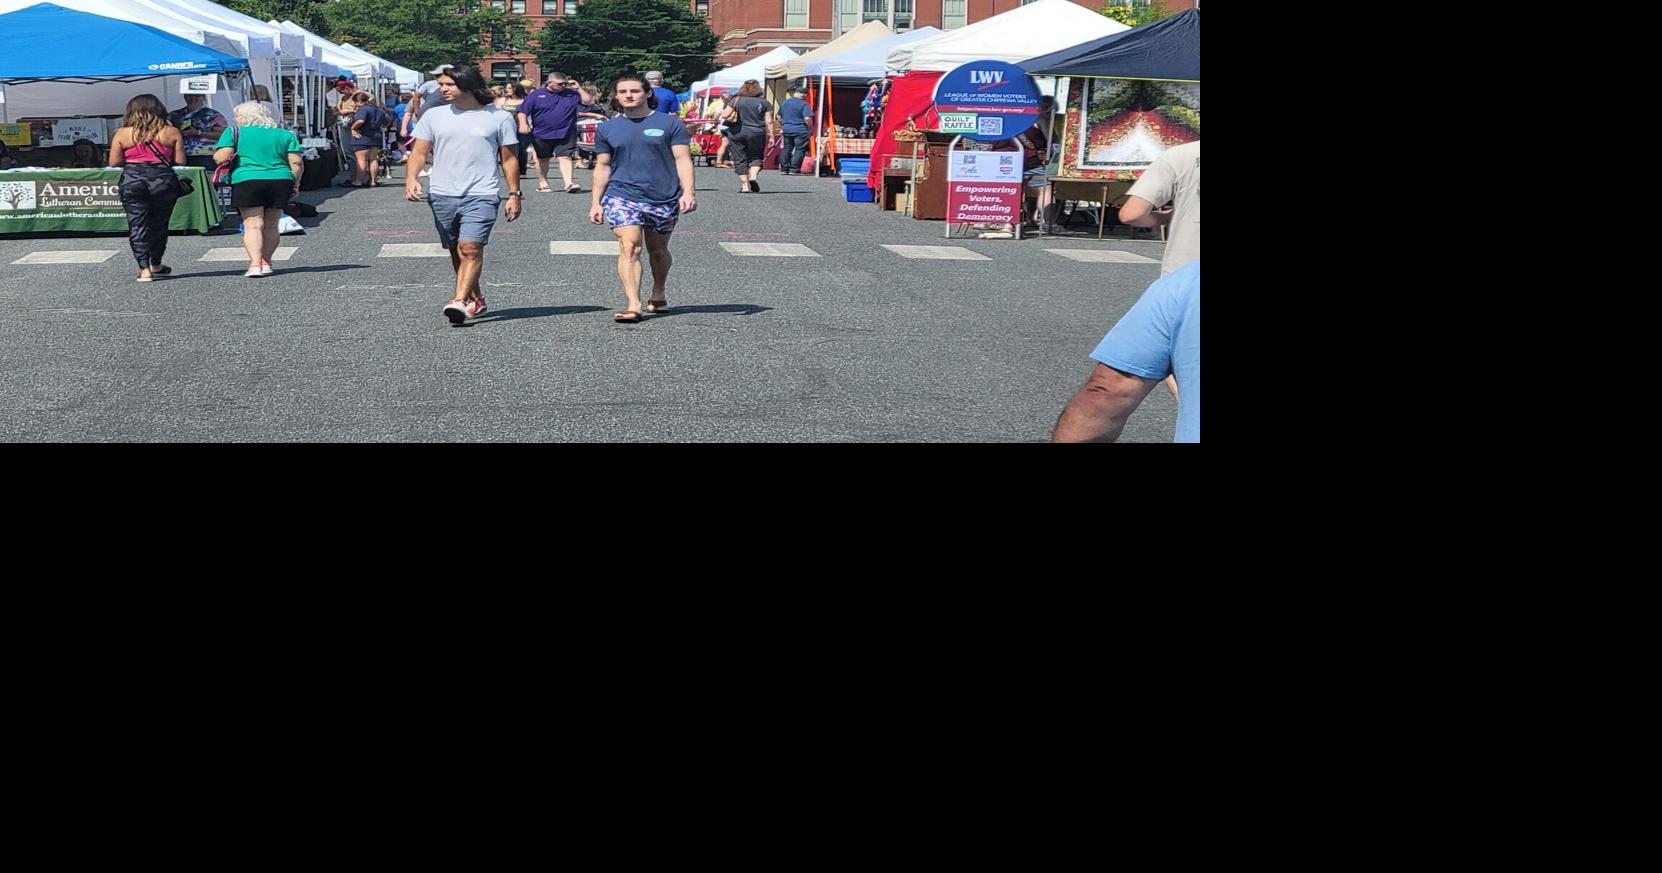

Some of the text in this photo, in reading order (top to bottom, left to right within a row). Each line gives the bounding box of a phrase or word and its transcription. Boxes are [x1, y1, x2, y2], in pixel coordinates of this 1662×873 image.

[160, 62, 194, 70] GANDER
[970, 70, 1004, 84] LWV
[40, 181, 120, 196] Americ
[956, 185, 1017, 195] Empowering
[40, 196, 82, 207] Lutheran
[969, 195, 1003, 203] Voters,
[960, 204, 1011, 213] Defending
[957, 213, 1013, 222] Democracy
